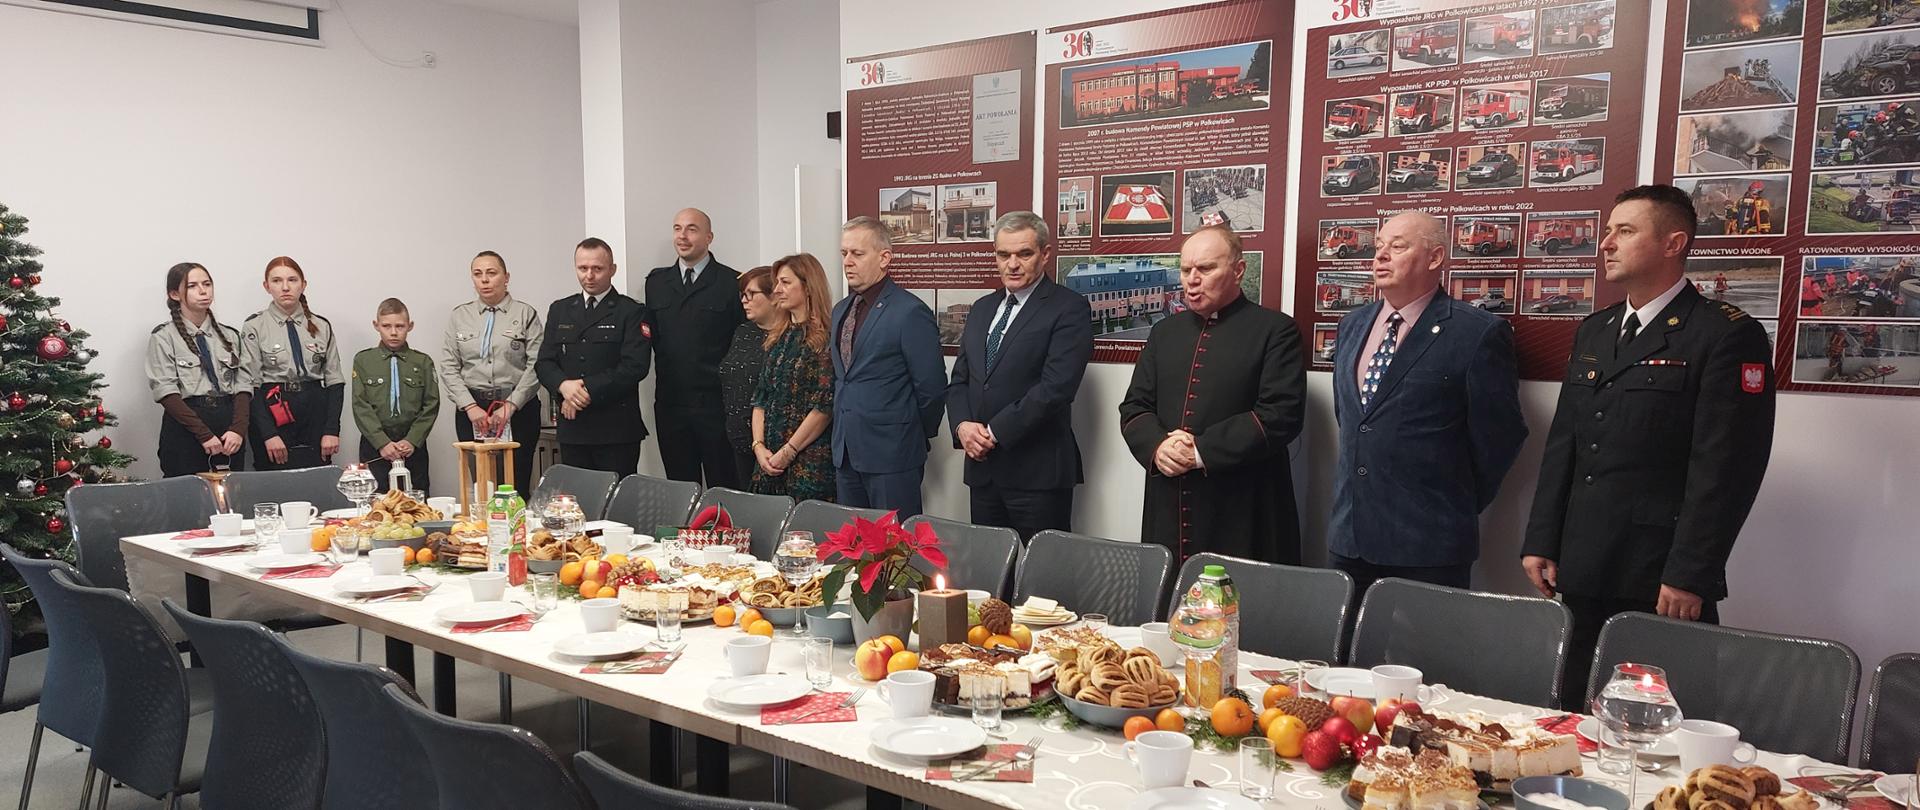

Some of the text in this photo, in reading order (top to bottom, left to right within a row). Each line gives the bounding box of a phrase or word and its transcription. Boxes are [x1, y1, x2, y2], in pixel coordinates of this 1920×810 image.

[1380, 16, 1421, 26] Wyposażenie
[1444, 4, 1486, 17] Polkowicach
[1495, 2, 1516, 11] latach
[1063, 30, 1094, 58] 30
[860, 62, 885, 86] 30
[1380, 82, 1422, 93] Wyposażenie
[1460, 72, 1502, 84] Polkowicach
[1529, 70, 1549, 78] 2017
[1150, 122, 1182, 132] Powiatowej
[1200, 117, 1235, 126] Polkowicach
[1450, 204, 1490, 213] Polkowicach
